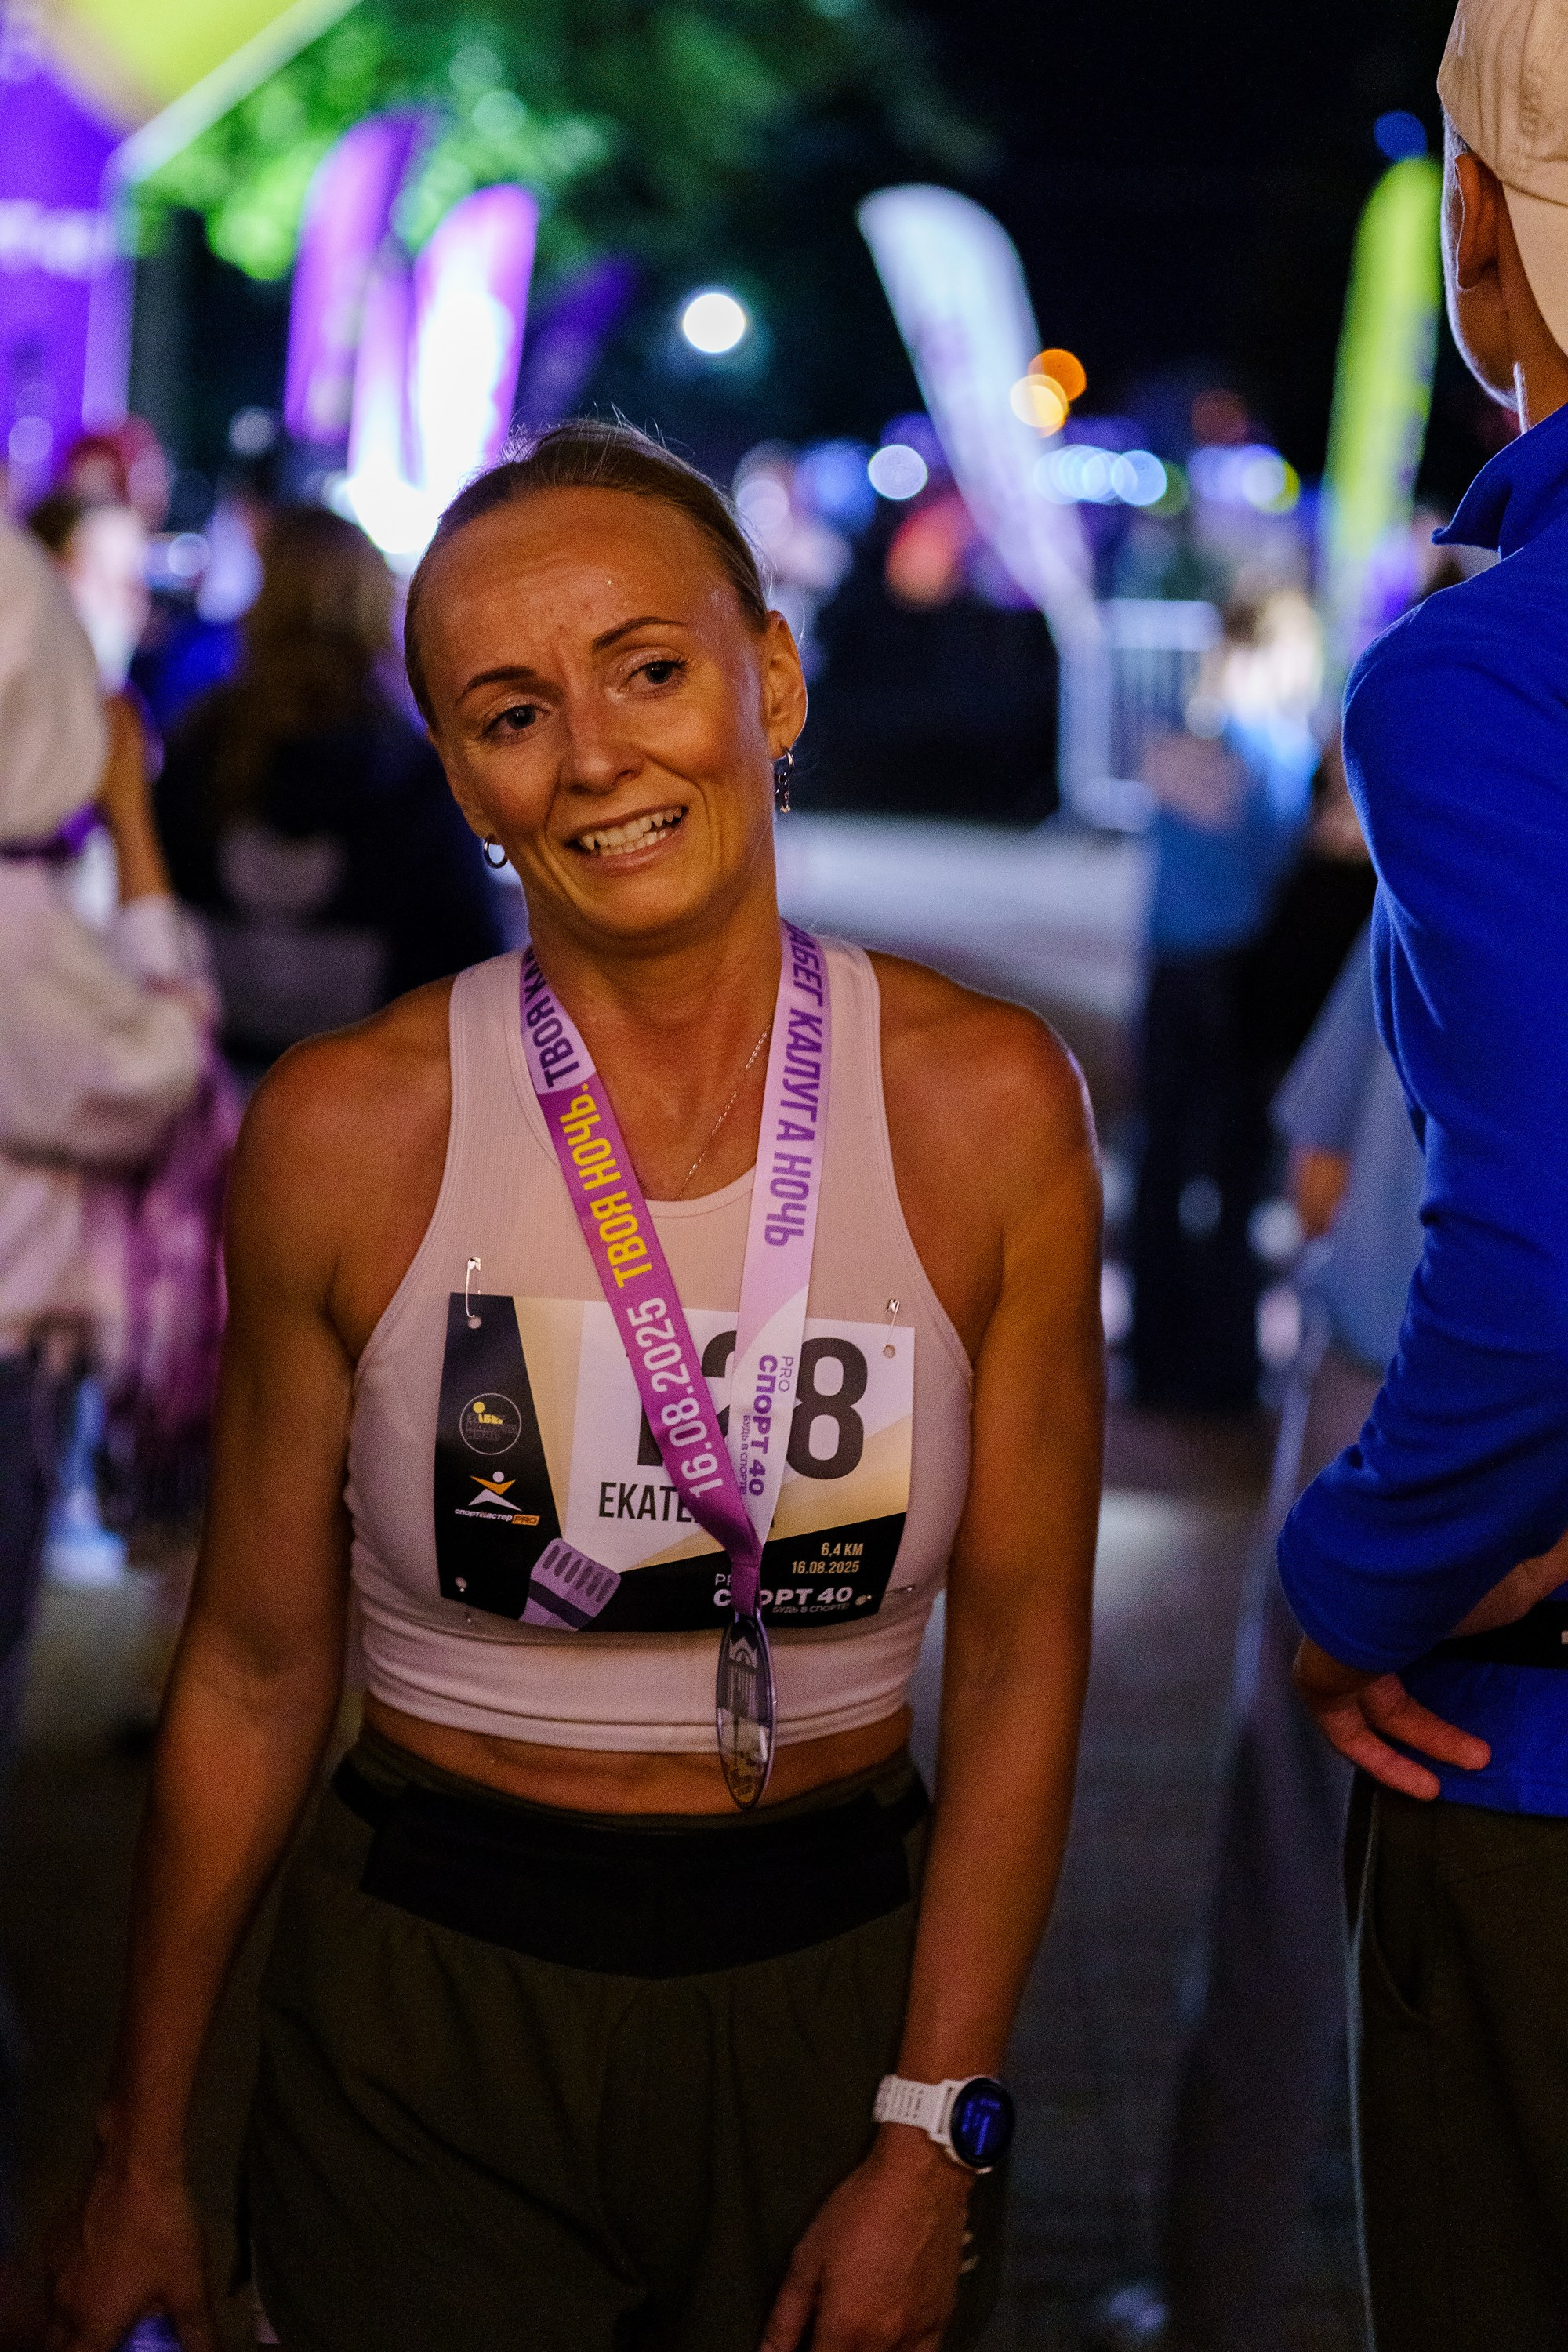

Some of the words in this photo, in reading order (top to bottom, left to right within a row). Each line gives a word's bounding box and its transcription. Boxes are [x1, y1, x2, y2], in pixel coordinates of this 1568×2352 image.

[526, 996, 580, 1089] ТВОЯ
[776, 1007, 823, 1141] КАЛУГА
[590, 1189, 653, 1289] ТВОЯ
[764, 1152, 813, 1247] НОЧЬ
[626, 1297, 724, 1500] 16.08.2025
[750, 1354, 779, 1454] СПОРТ
[778, 1356, 794, 1392] PRO
[748, 1459, 767, 1497] 40
[713, 1588, 813, 1606] СОРТ
[818, 1586, 853, 1604] 40
[791, 1560, 859, 1574] 16.08.2025
[820, 1541, 841, 1558] 6,4
